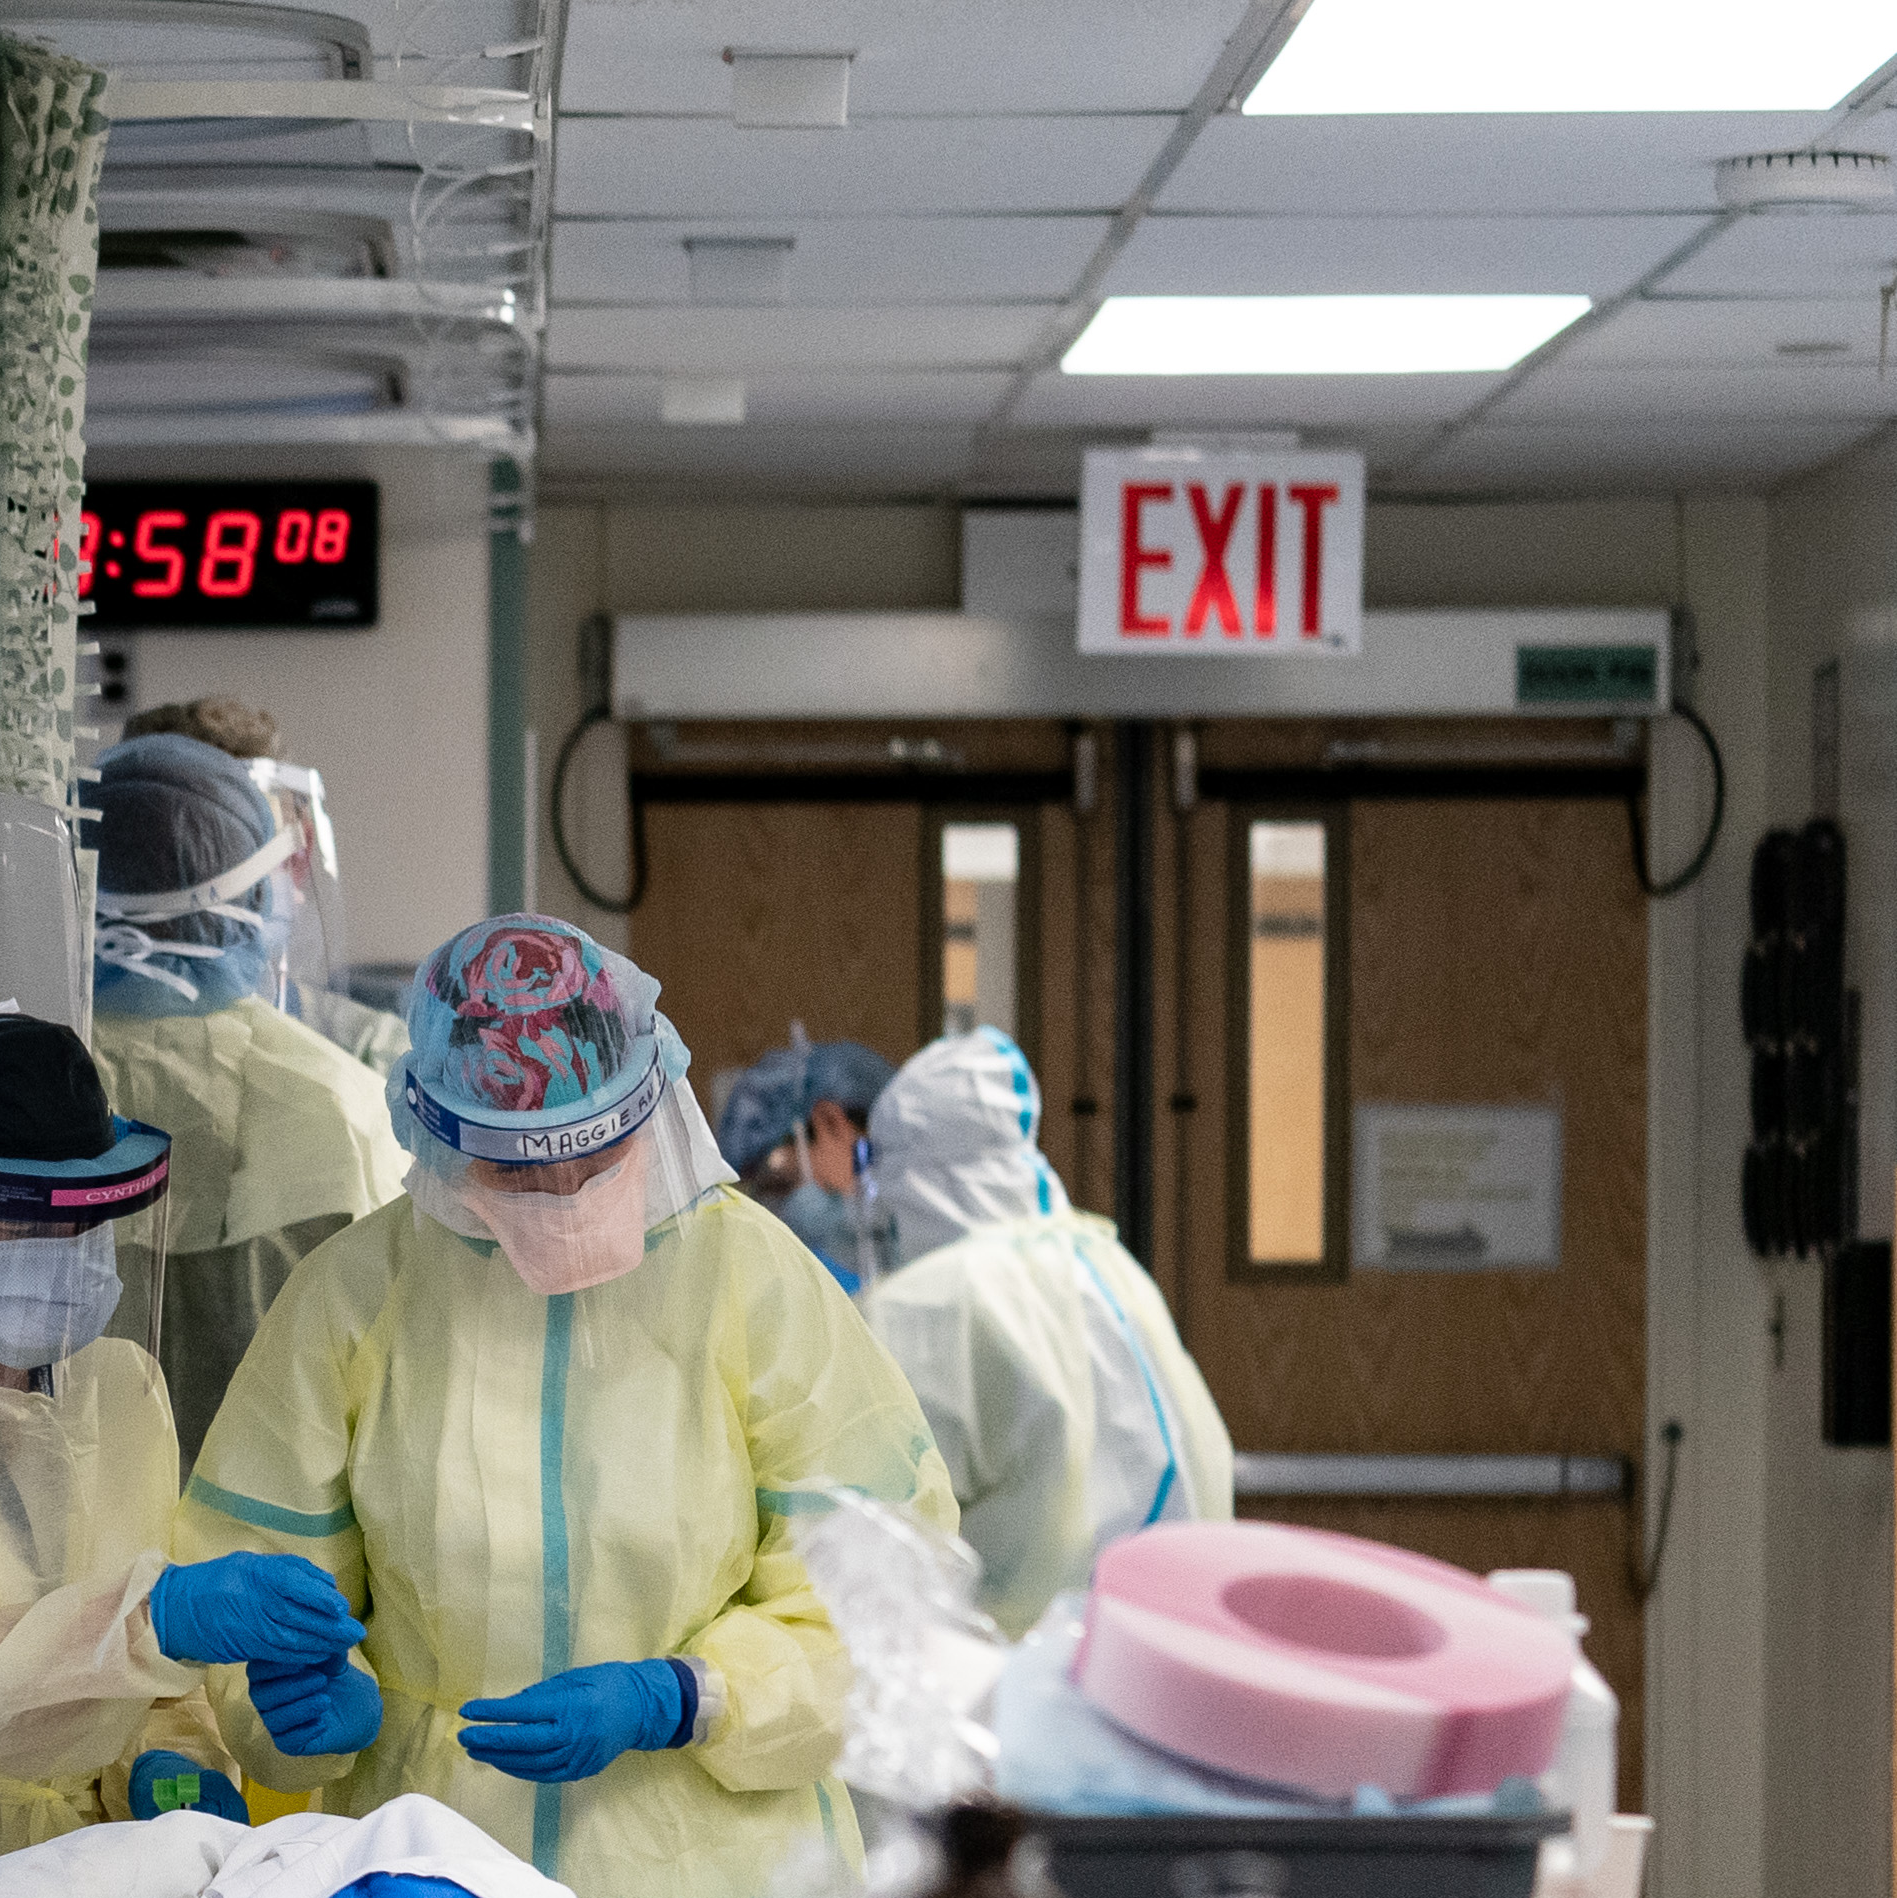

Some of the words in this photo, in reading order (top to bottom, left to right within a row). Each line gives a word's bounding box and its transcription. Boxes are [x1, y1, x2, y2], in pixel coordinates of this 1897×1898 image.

[274, 508, 351, 563] 08
[1118, 481, 1340, 638] EXIT
[85, 1174, 157, 1202] CYNTHIA
